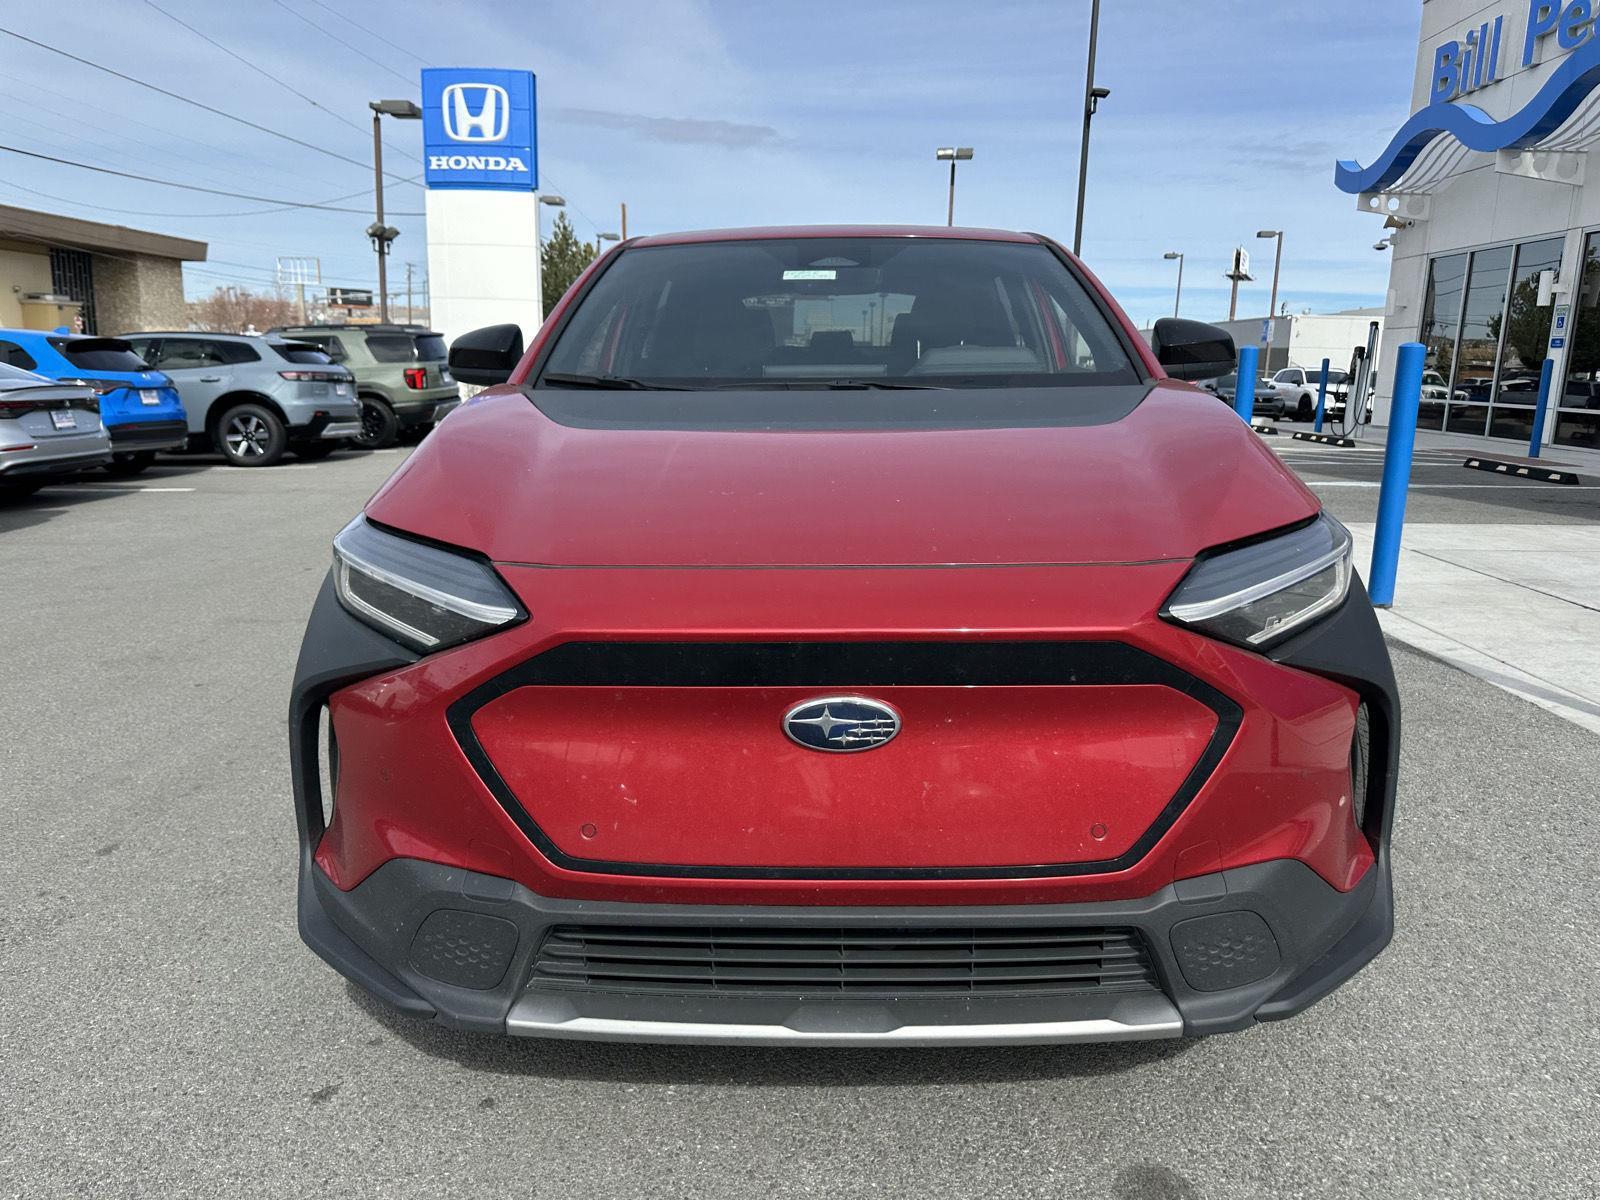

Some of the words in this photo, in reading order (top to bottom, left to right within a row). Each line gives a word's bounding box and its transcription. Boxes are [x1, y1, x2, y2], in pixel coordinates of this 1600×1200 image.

[1429, 15, 1503, 106] Bill
[1521, 0, 1600, 67] Pe
[428, 155, 529, 172] HONDA
